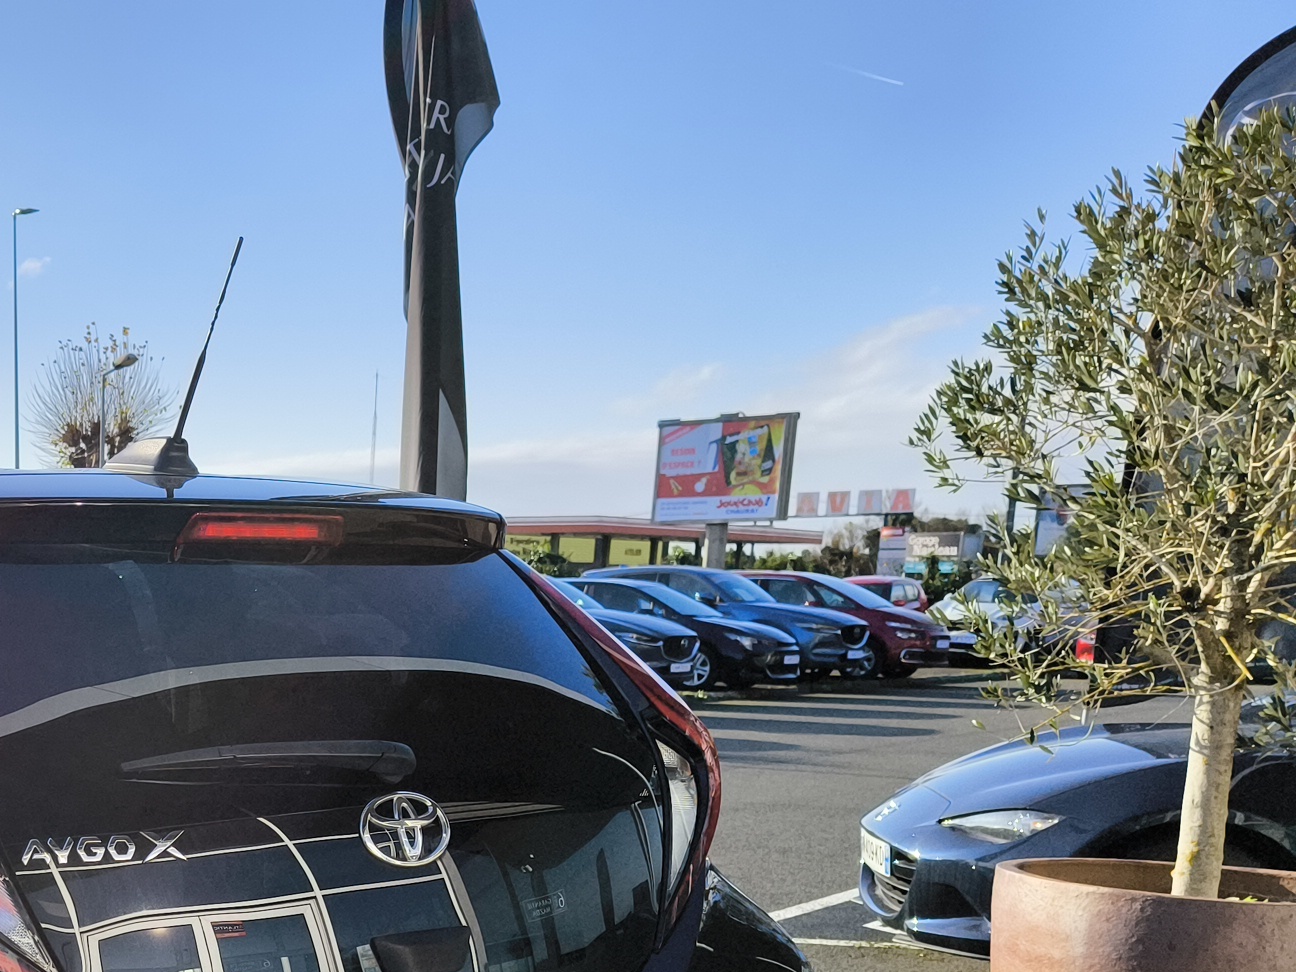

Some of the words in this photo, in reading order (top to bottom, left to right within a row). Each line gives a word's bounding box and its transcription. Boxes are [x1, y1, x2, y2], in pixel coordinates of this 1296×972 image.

[798, 489, 913, 514] AVIA
[21, 835, 136, 866] AYGO
[139, 830, 188, 863] X
